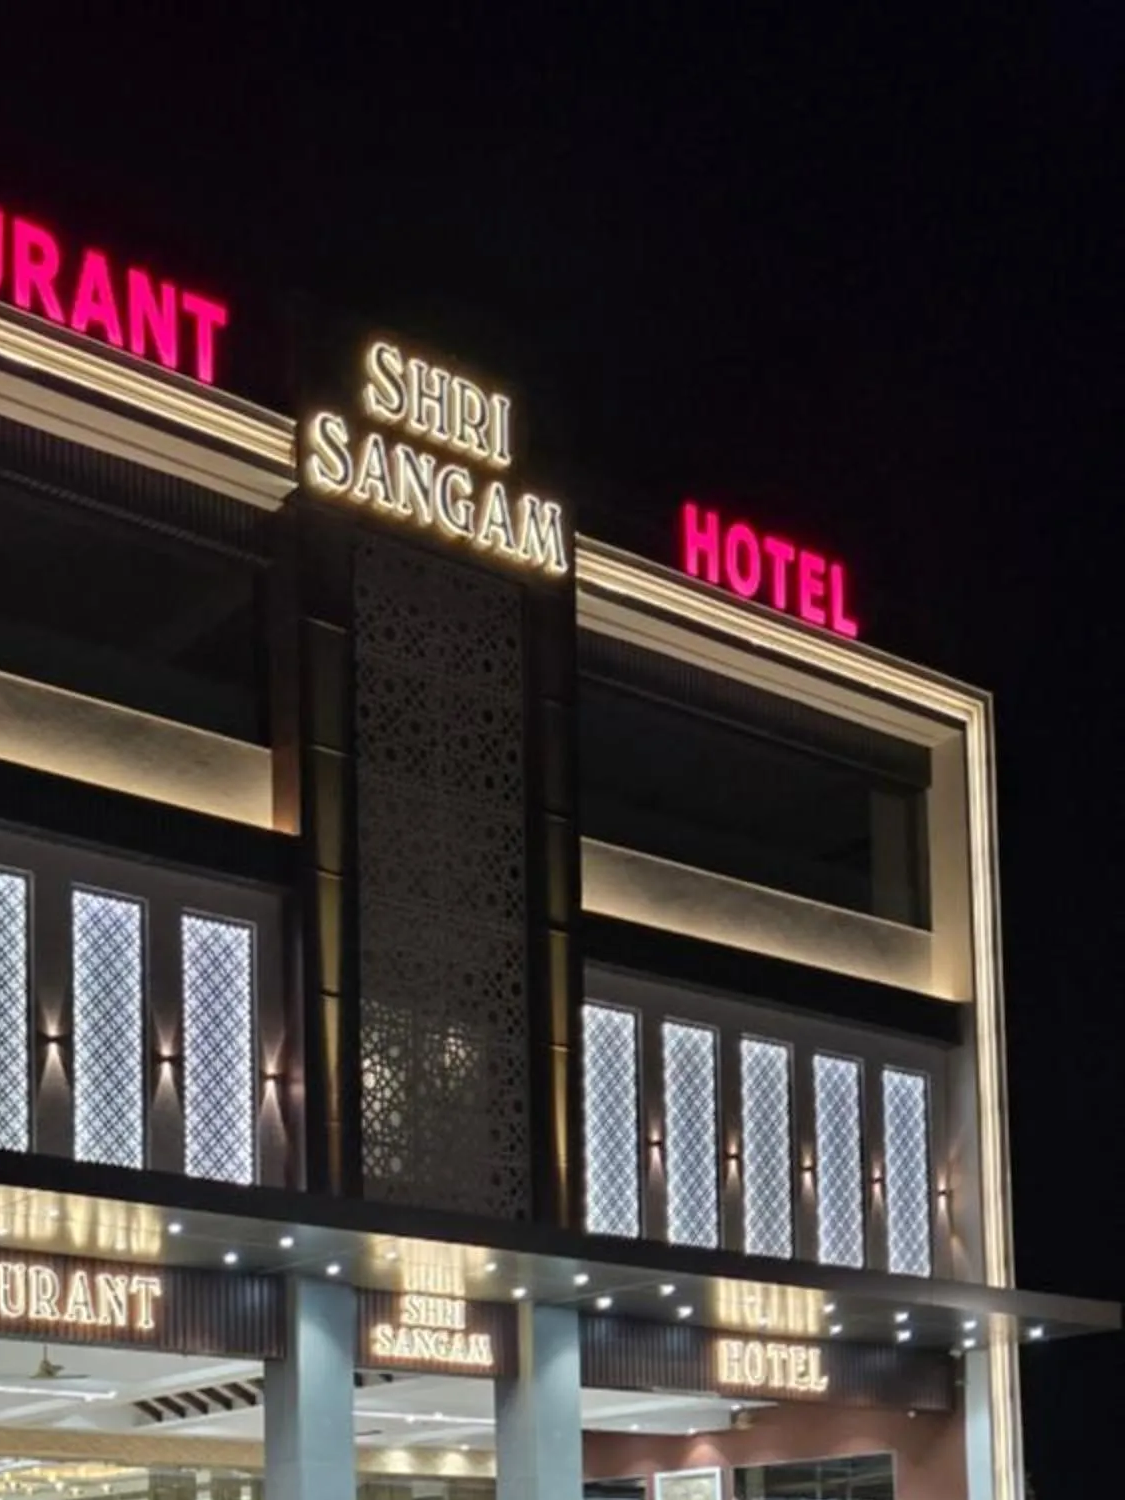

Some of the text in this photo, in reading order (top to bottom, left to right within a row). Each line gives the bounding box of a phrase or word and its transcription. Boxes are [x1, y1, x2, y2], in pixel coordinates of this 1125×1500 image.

[364, 341, 512, 466] SHRI
[306, 410, 568, 575] SANGAM
[682, 503, 858, 637] HOTEL
[371, 1323, 494, 1366] SANGAM
[400, 1295, 466, 1330] SHRI
[718, 1339, 828, 1392] HOTEL
